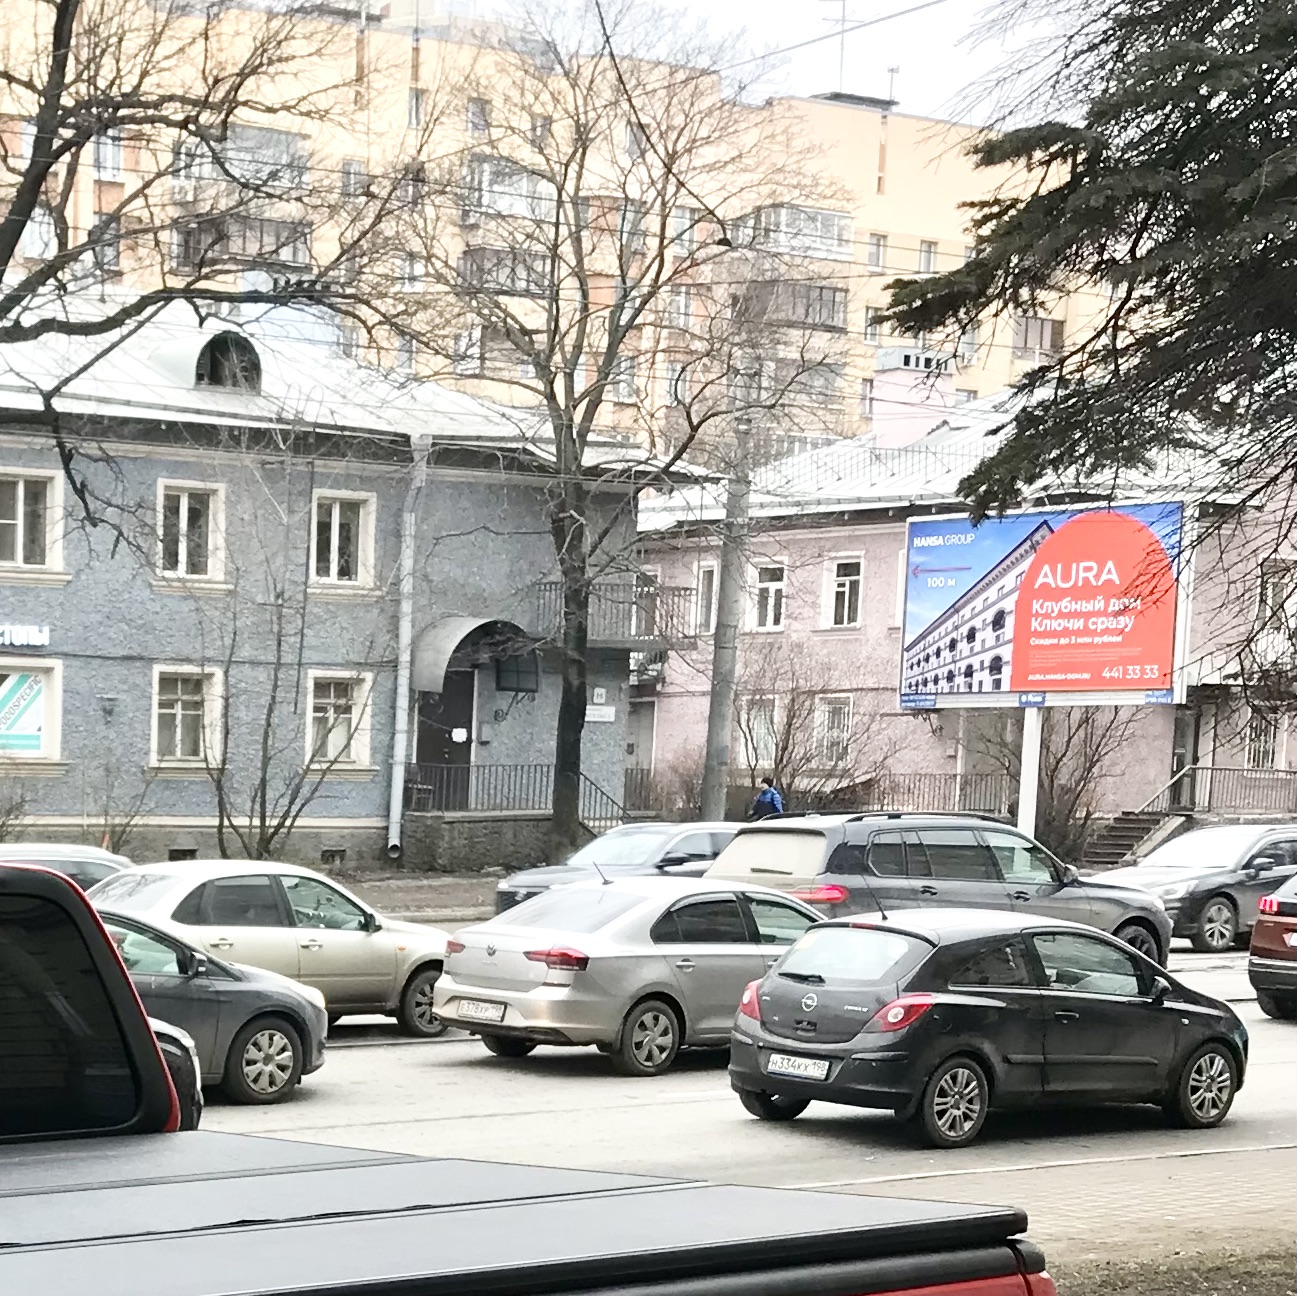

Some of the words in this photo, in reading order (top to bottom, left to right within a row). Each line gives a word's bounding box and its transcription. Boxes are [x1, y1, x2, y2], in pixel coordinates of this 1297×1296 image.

[913, 535, 944, 548] HANSA
[944, 533, 976, 546] GROUP
[927, 577, 944, 588] 100
[1034, 560, 1120, 589] AURA
[1032, 595, 1105, 617] Клубный
[1030, 616, 1084, 632] Ключи
[1088, 615, 1136, 633] сразу
[1102, 666, 1123, 679] 441
[1125, 665, 1141, 679] 33
[1143, 664, 1159, 679] 33
